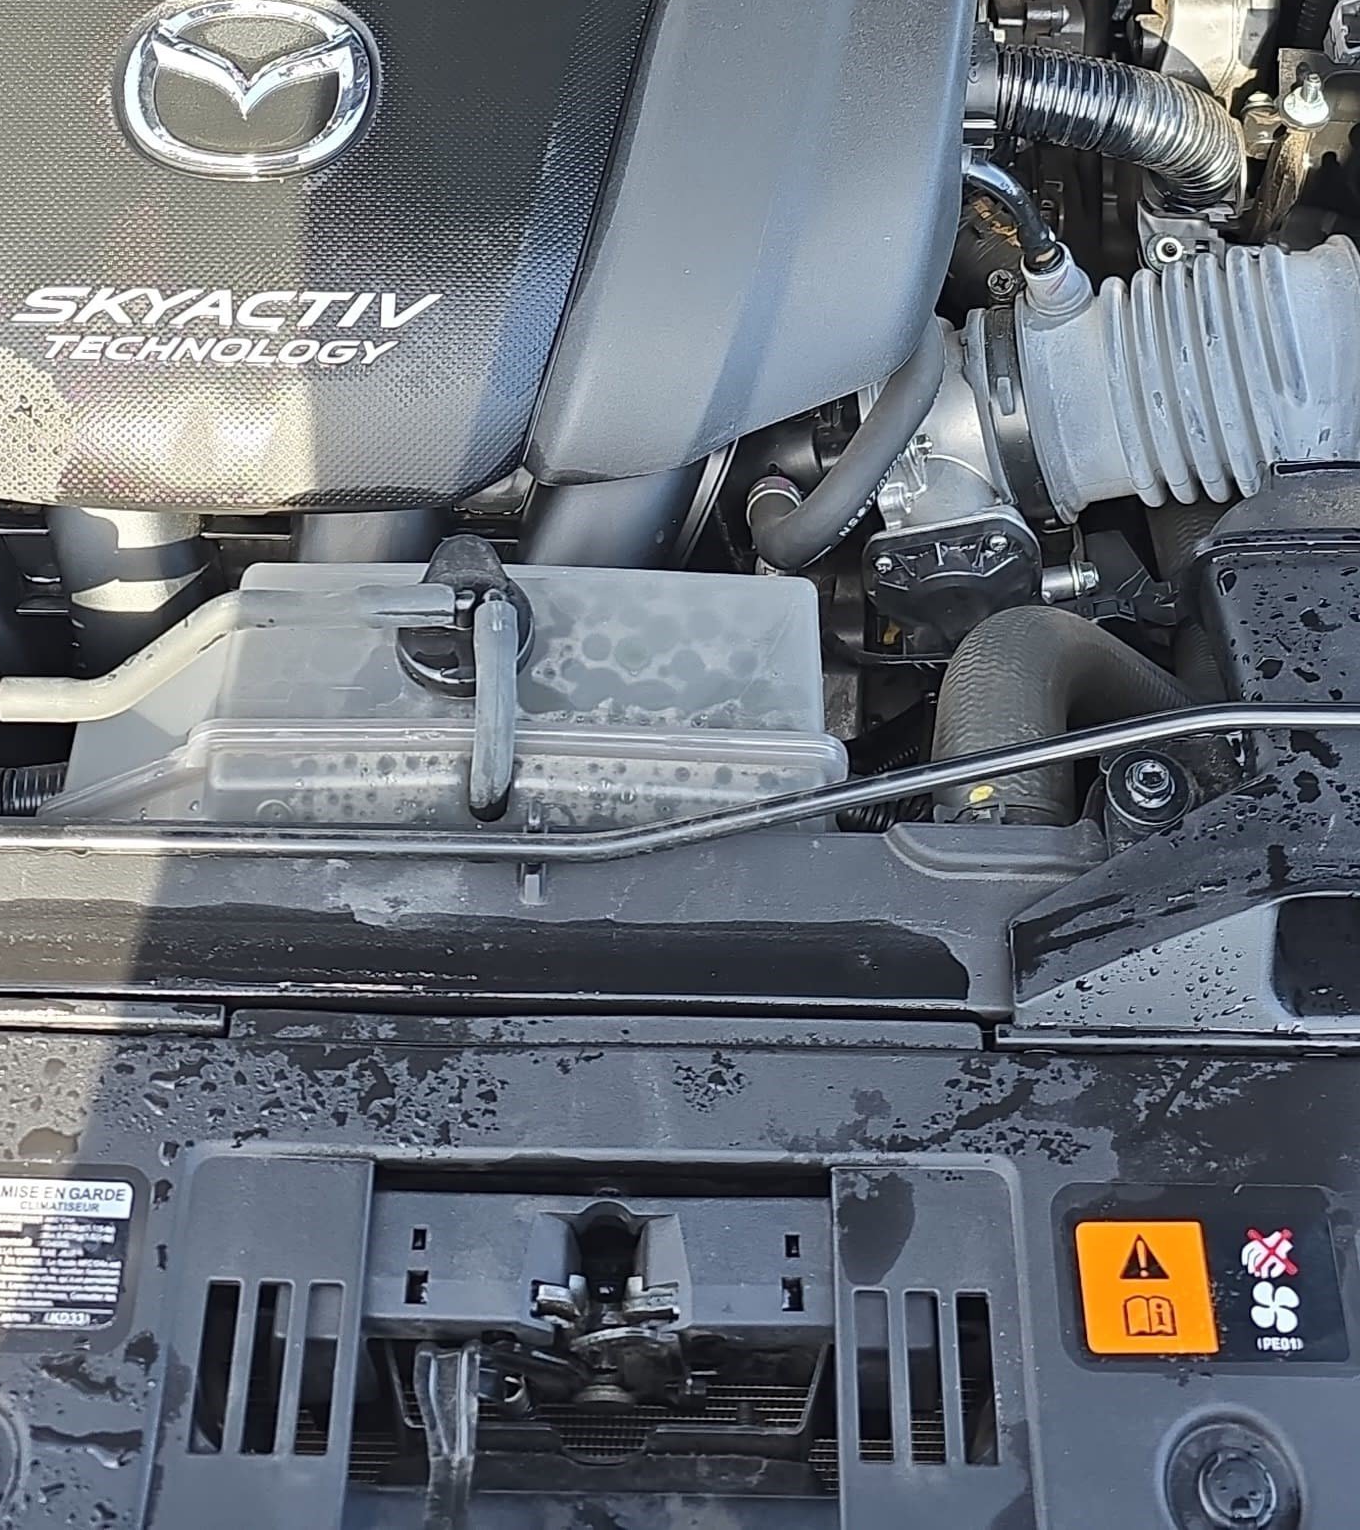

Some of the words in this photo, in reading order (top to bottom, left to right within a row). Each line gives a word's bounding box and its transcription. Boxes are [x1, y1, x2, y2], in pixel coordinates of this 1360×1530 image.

[10, 285, 444, 332] SKYACTIV
[44, 334, 400, 365] TECHNOLOGY
[0, 1184, 40, 1199] MISE
[43, 1186, 66, 1200] EN
[68, 1187, 127, 1202] GARDE
[20, 1200, 100, 1213] CLIMATISEUR
